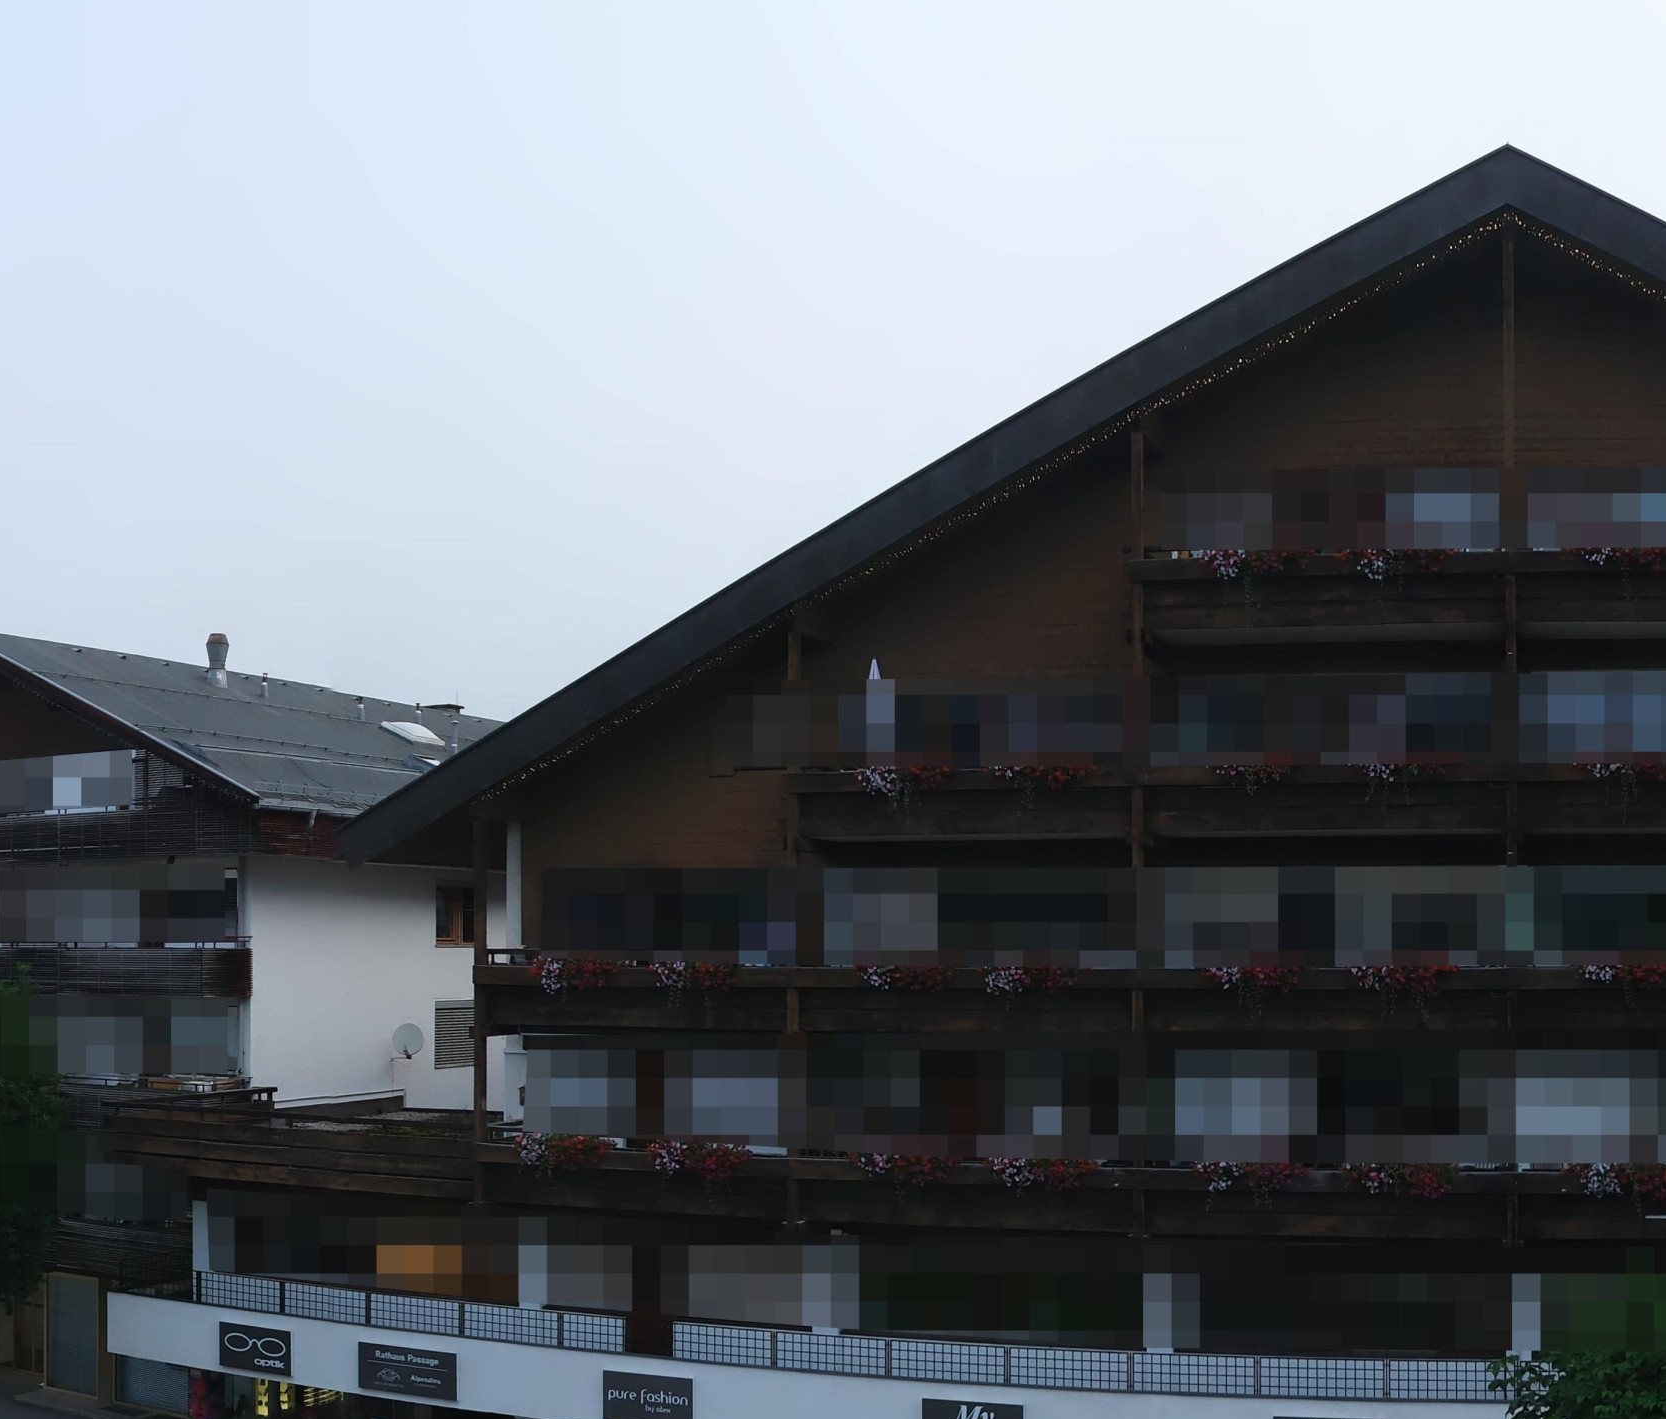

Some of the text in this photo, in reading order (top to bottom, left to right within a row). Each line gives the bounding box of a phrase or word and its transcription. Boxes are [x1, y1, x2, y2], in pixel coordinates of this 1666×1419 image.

[254, 1358, 285, 1369] optik
[375, 1350, 439, 1366] Rathaus Passage
[608, 1389, 637, 1401] pure
[645, 1404, 654, 1414] by
